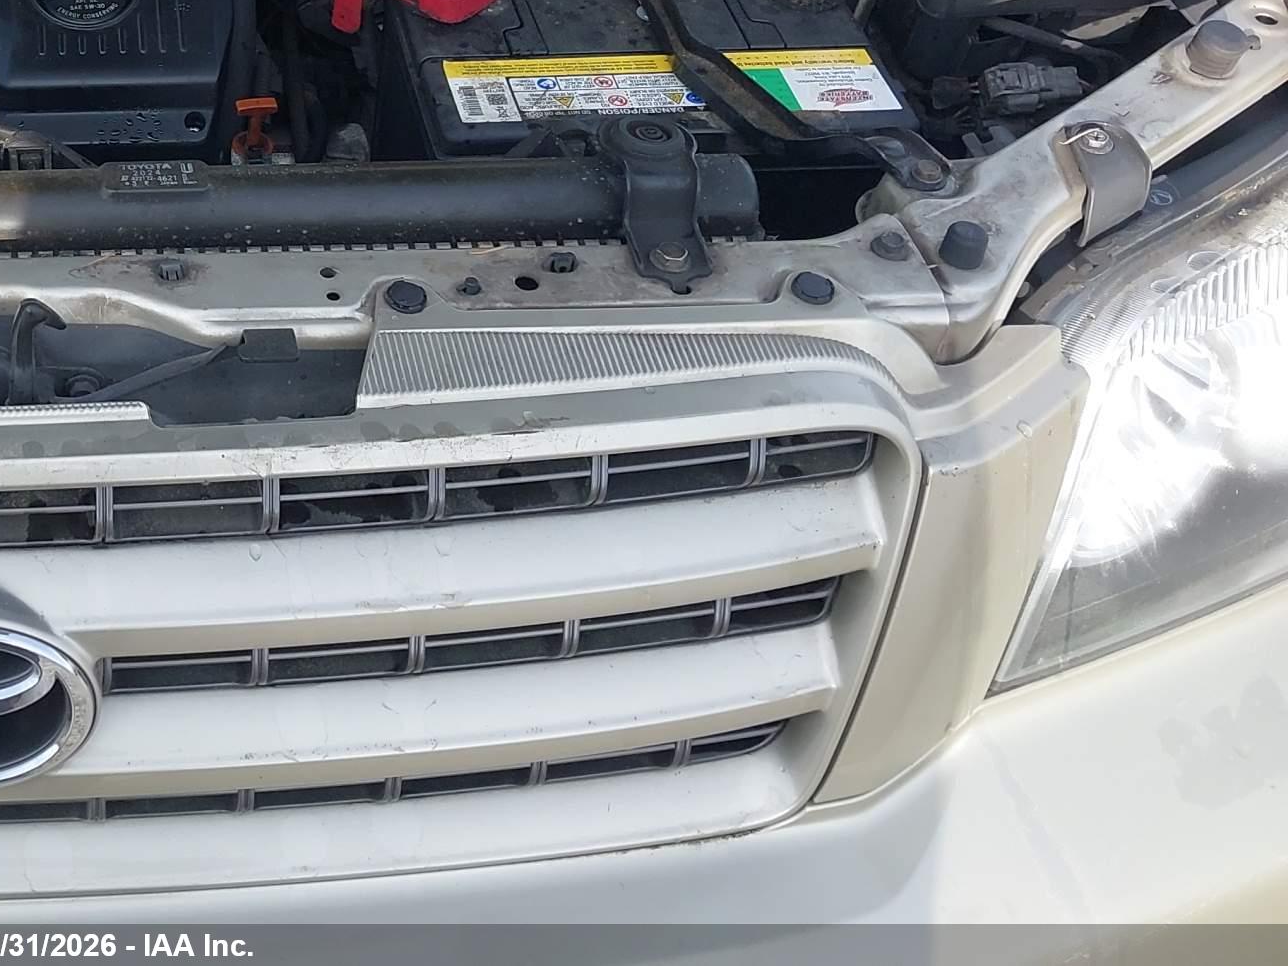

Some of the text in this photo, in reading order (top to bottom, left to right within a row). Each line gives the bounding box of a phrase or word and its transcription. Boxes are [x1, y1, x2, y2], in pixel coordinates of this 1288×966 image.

[817, 94, 873, 103] INTERSTATE
[598, 107, 684, 115] DANGER/POISON
[120, 163, 172, 171] TOYOTA
